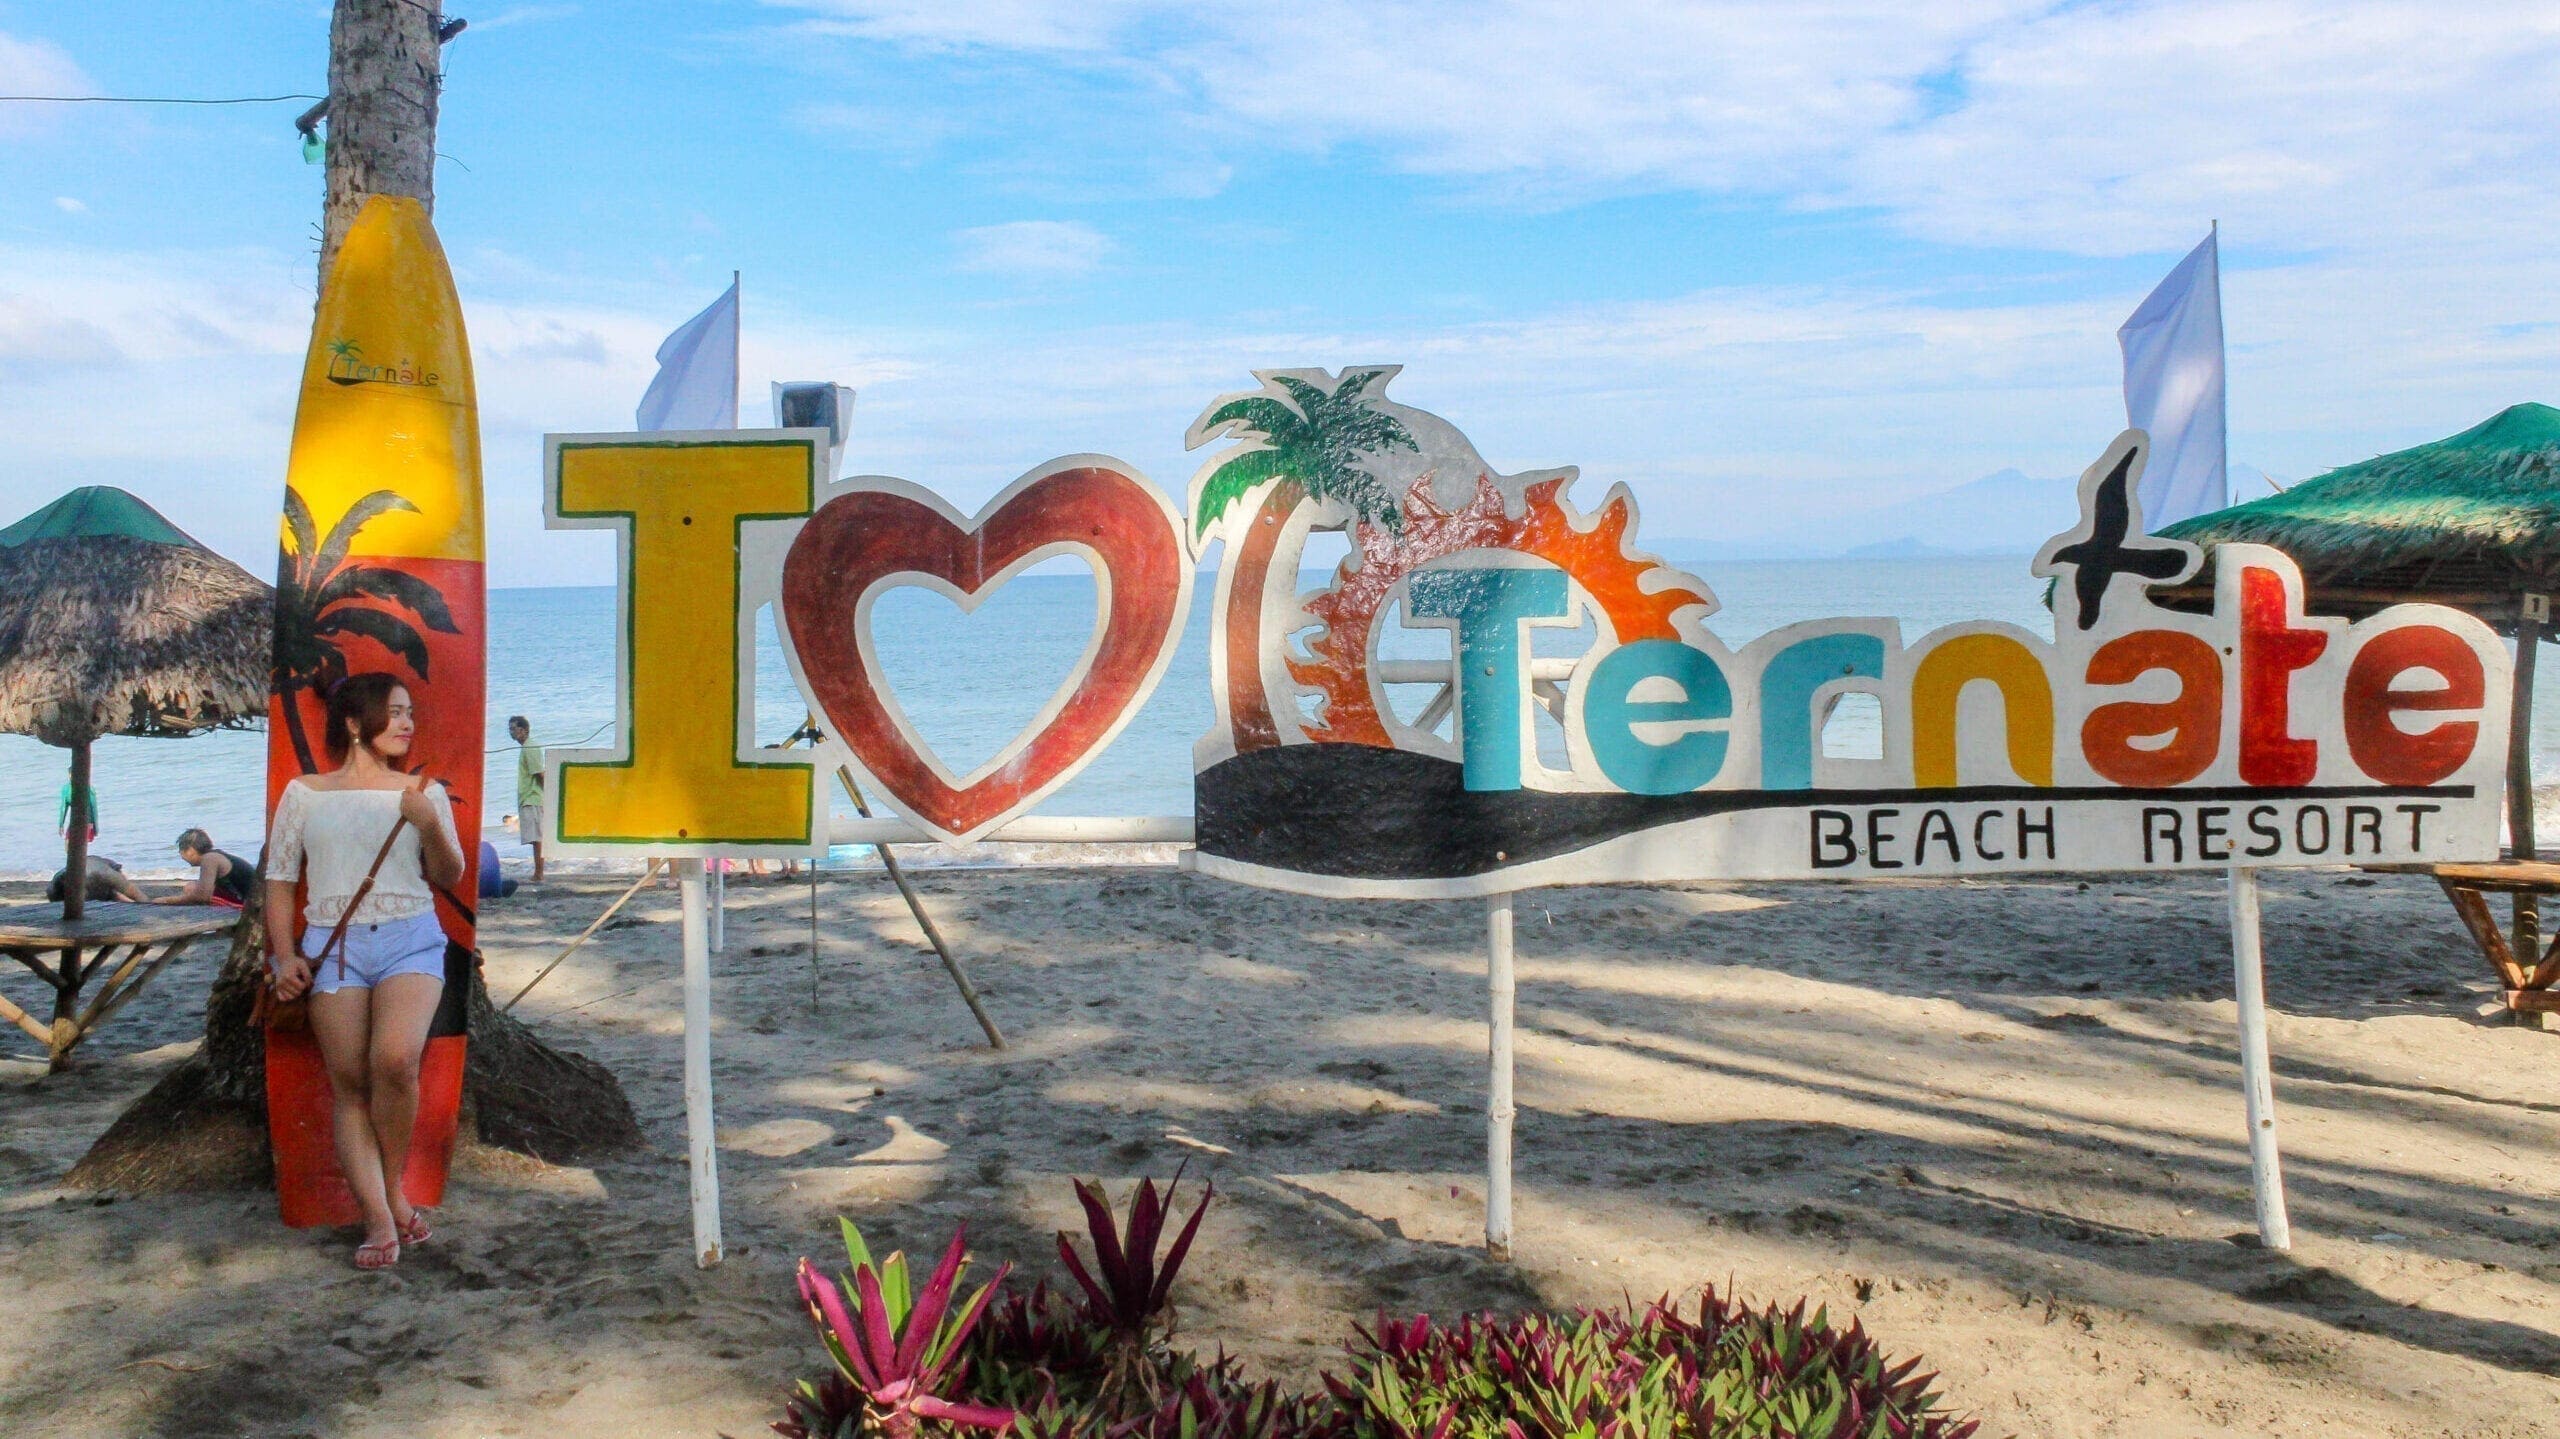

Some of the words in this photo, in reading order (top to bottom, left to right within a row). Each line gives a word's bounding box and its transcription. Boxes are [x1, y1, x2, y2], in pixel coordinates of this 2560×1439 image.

[557, 440, 814, 844] I
[1410, 566, 2486, 796] Ternate
[1809, 805, 2056, 870] BEACH
[2143, 804, 2441, 864] RESORT
